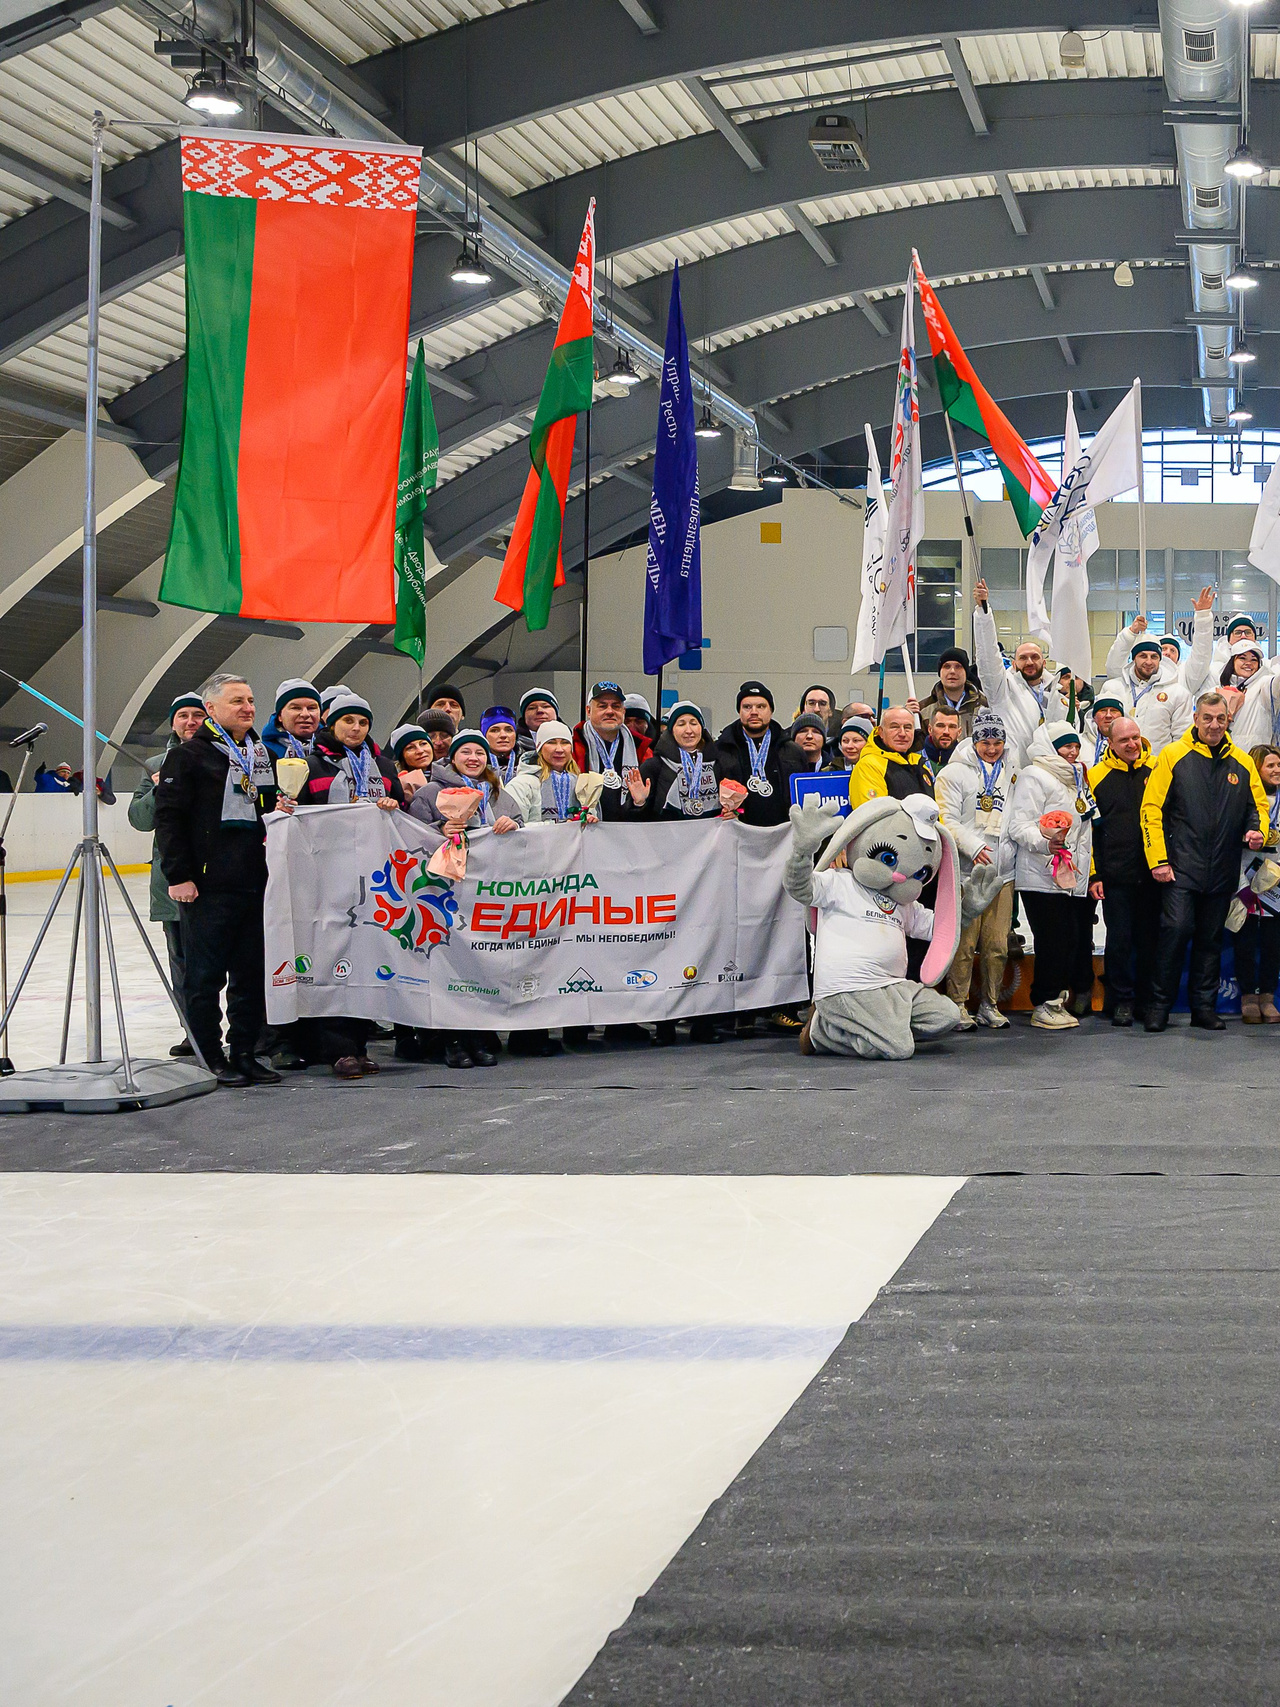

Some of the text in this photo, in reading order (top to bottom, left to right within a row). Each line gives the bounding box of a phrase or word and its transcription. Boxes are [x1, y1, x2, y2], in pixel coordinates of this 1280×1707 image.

[476, 873, 599, 897] КОМАНДА
[470, 893, 677, 940] ЕДИНЫЕ
[471, 941, 503, 952] КОГДА
[506, 940, 525, 950] МЫ
[528, 936, 561, 950] ЕДИНЫ
[576, 933, 596, 944] МЫ
[598, 930, 676, 943] НЕПОБЕДИМЫ!
[447, 984, 500, 996] ВОСТОЧНЫЙ
